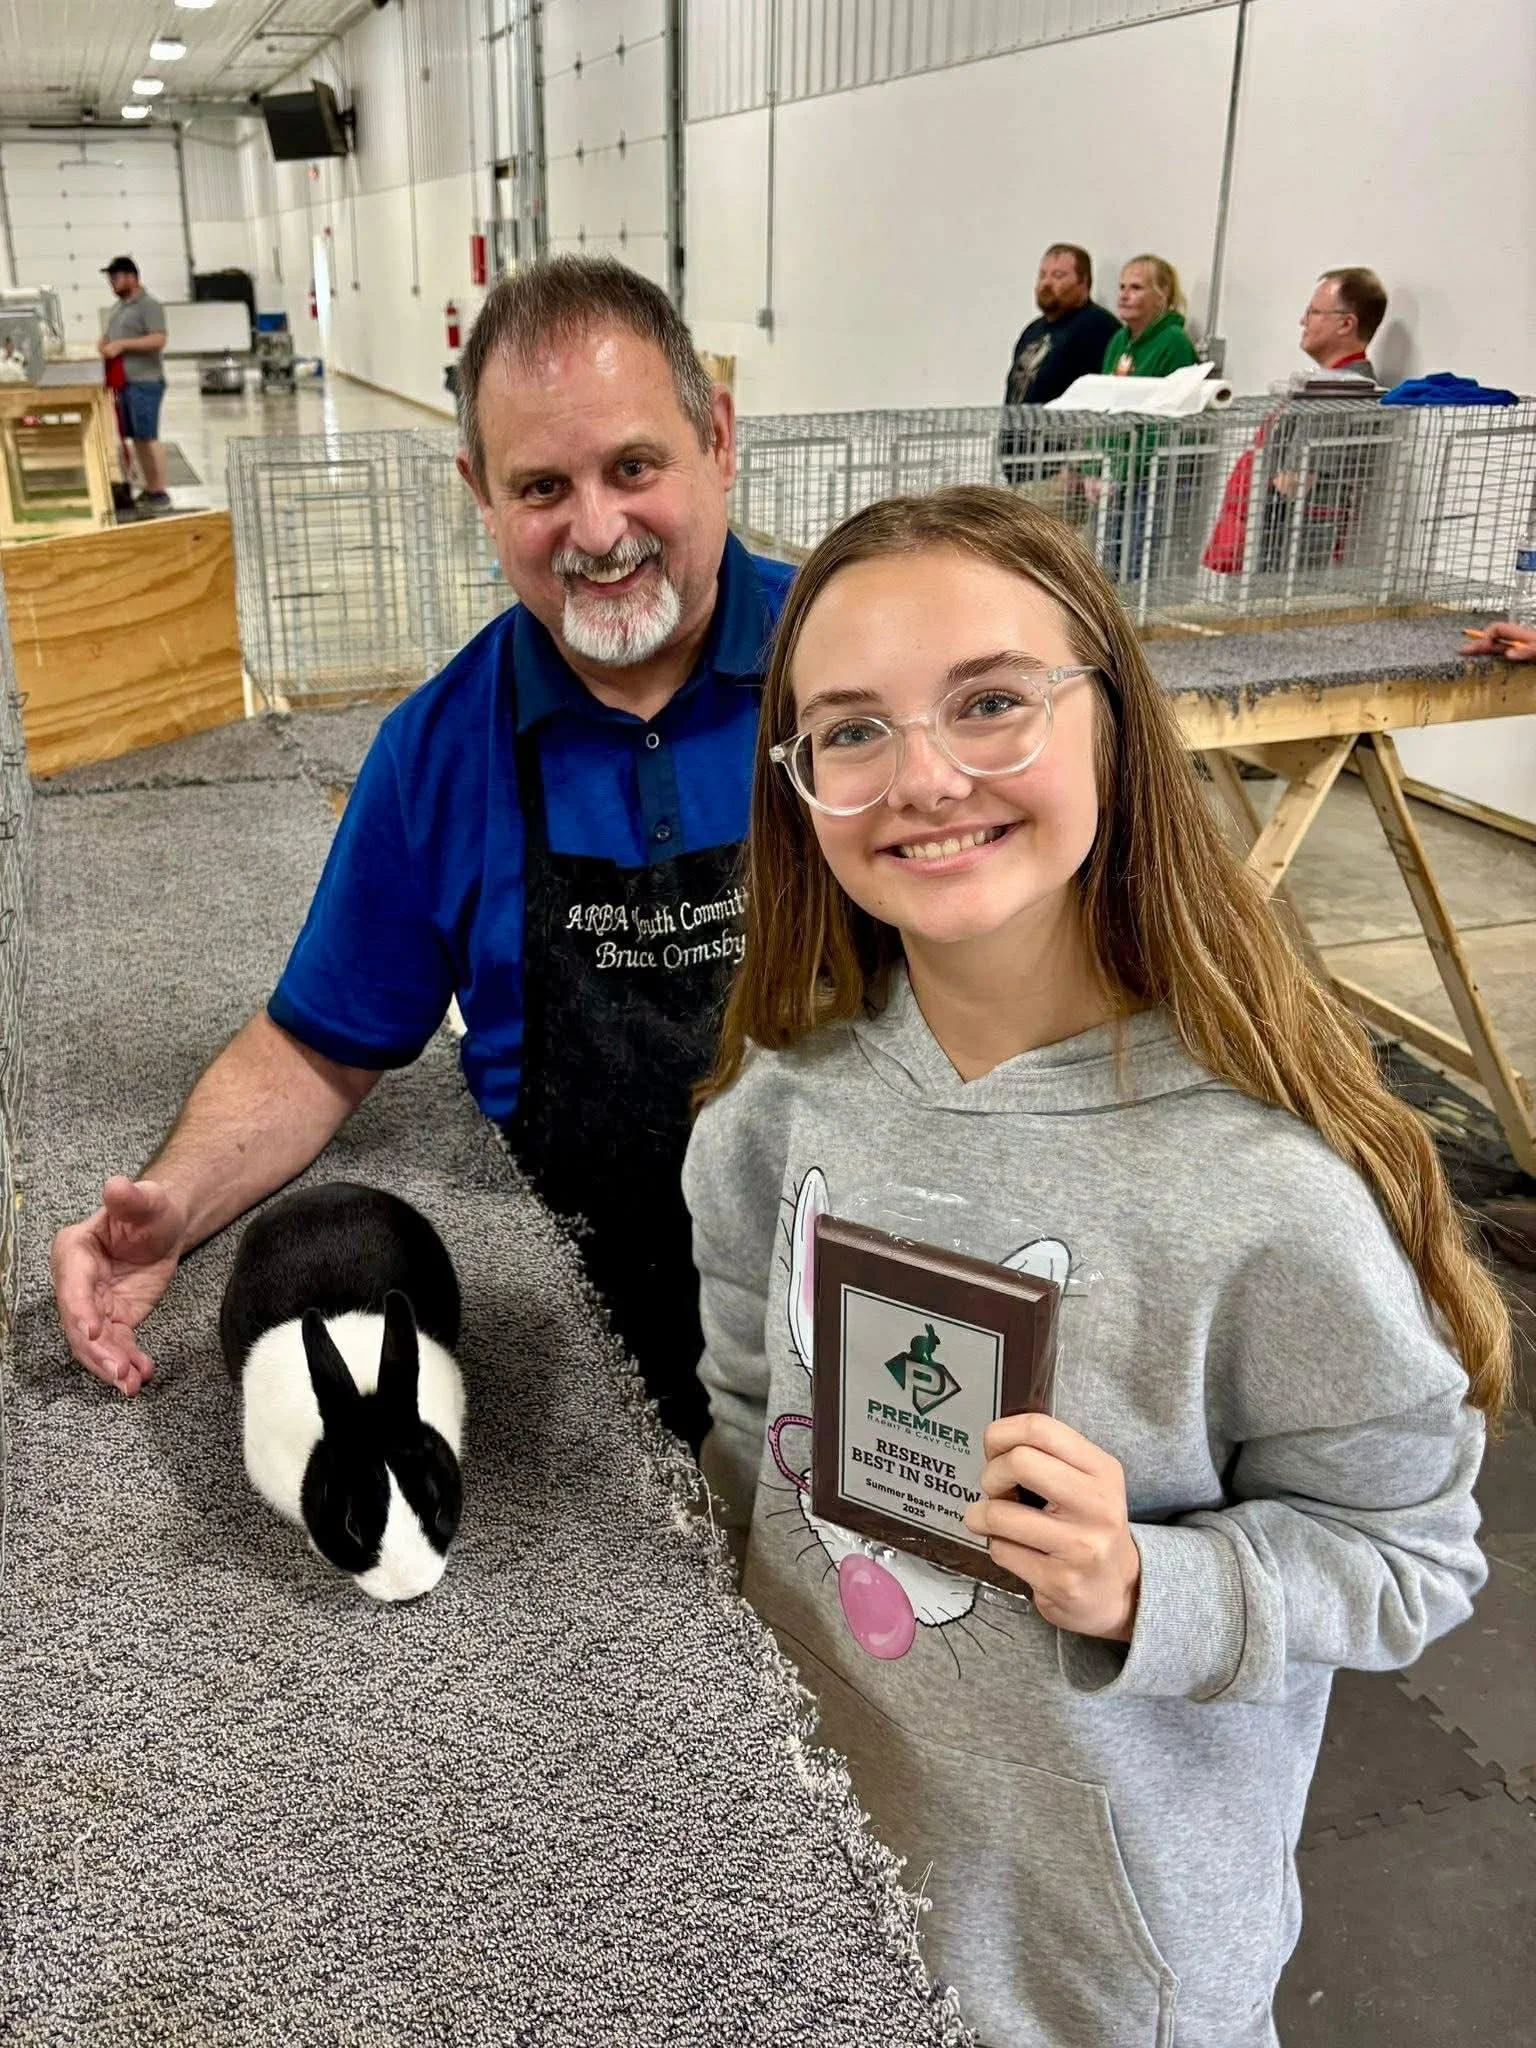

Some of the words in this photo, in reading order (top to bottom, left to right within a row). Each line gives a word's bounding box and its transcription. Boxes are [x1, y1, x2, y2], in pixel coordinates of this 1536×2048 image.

[566, 904, 629, 936] ARBA
[596, 941, 657, 969] Bruce
[663, 928, 746, 969] Ormsby
[867, 1398, 970, 1448] PREMIER
[851, 1446, 896, 1475] BEST
[898, 1463, 921, 1484] IN
[923, 1474, 981, 1503] SHOW
[875, 1438, 956, 1480] RESERVE
[865, 1477, 906, 1499] Summer
[906, 1492, 936, 1511] Beach
[937, 1504, 965, 1522] Party
[902, 1502, 926, 1519] 2025
